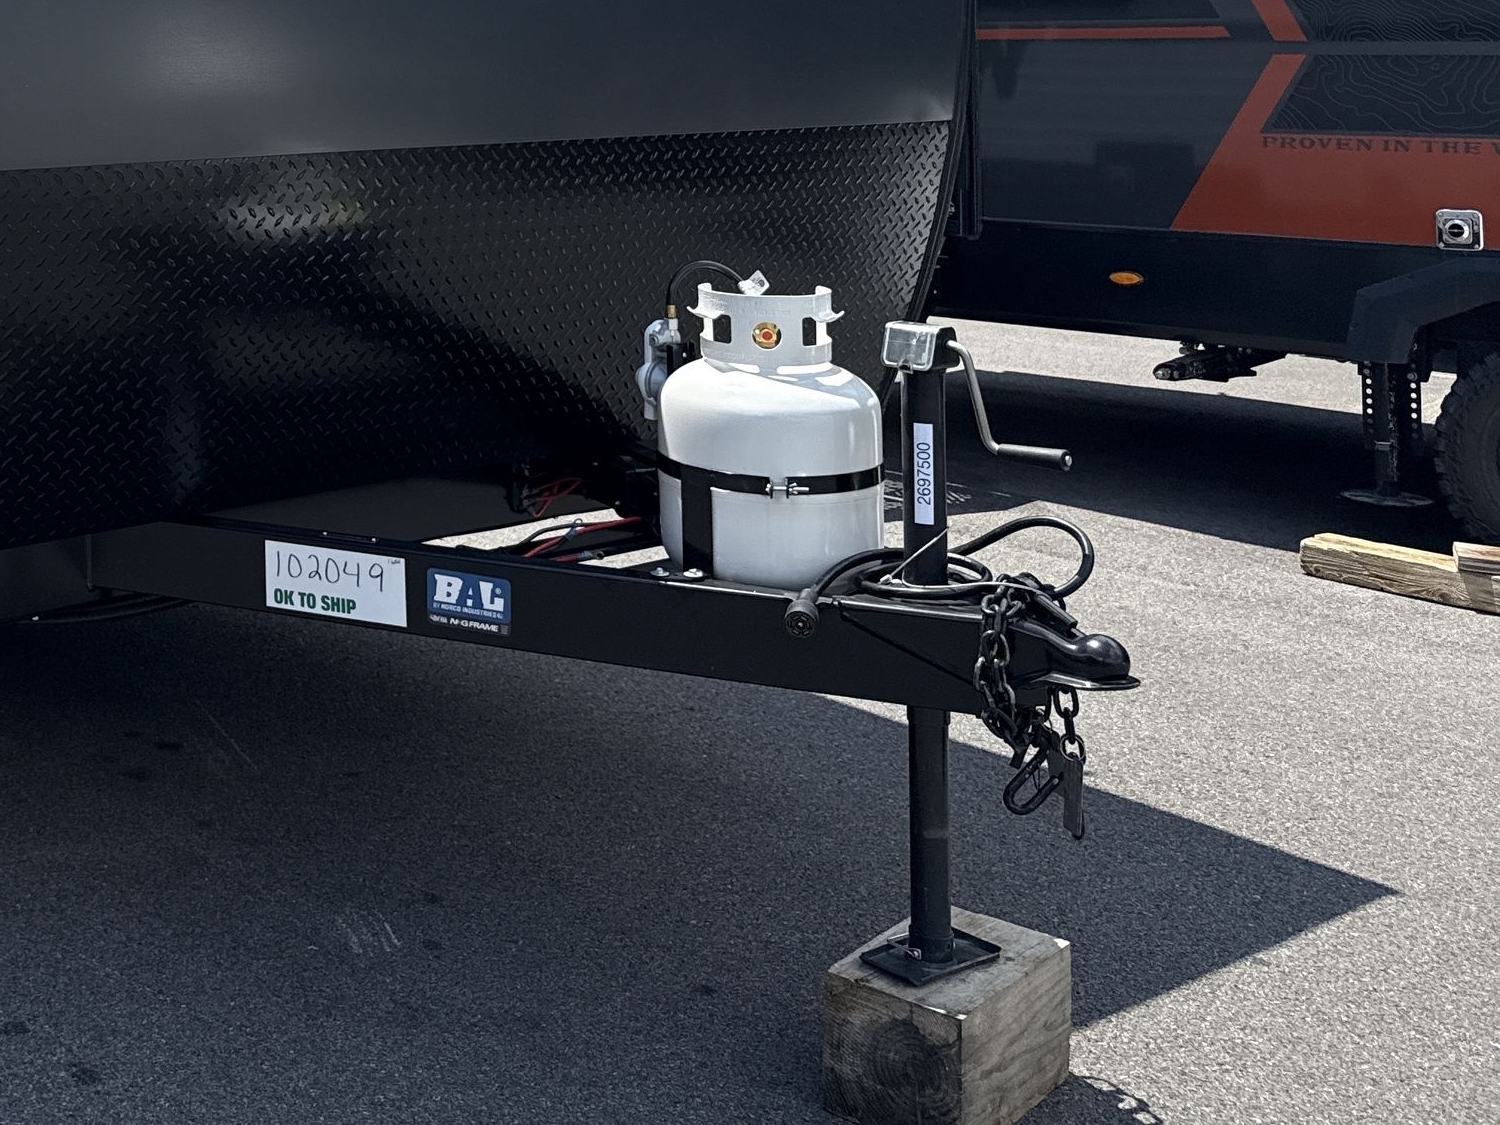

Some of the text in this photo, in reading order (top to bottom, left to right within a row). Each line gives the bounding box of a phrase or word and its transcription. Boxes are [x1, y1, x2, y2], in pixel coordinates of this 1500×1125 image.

[1262, 135, 1372, 152] PROVEN
[1383, 139, 1411, 153] IN
[1421, 140, 1482, 155] THE
[916, 442, 931, 506] 2697500
[277, 551, 383, 592] 102049
[274, 588, 356, 614] OK TO SHIP
[434, 574, 504, 612] BAL
